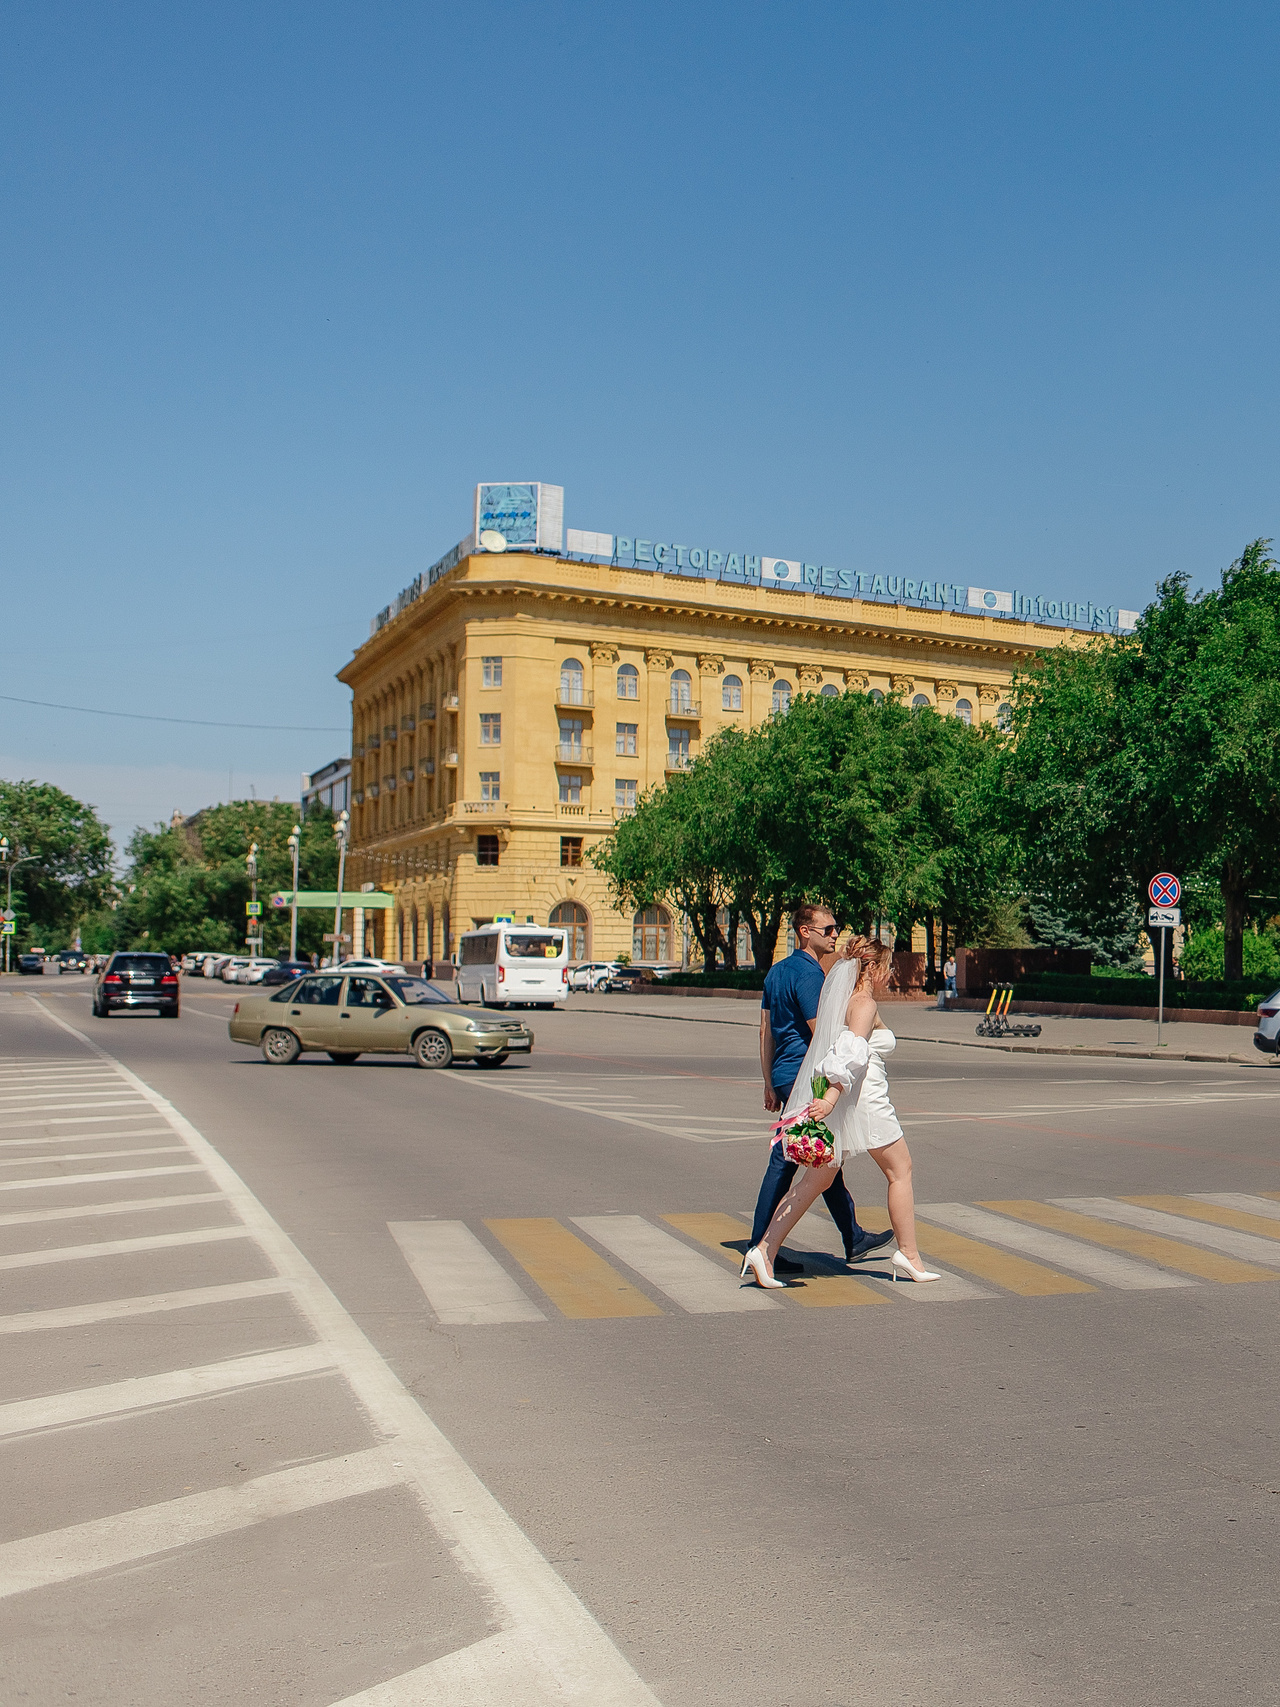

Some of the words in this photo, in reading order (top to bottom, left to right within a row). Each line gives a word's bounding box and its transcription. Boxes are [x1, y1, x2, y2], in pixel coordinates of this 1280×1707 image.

[615, 535, 761, 577] РЕСТОРАН
[802, 562, 965, 605] RESTAURANT
[1013, 589, 1116, 627] Intourist
